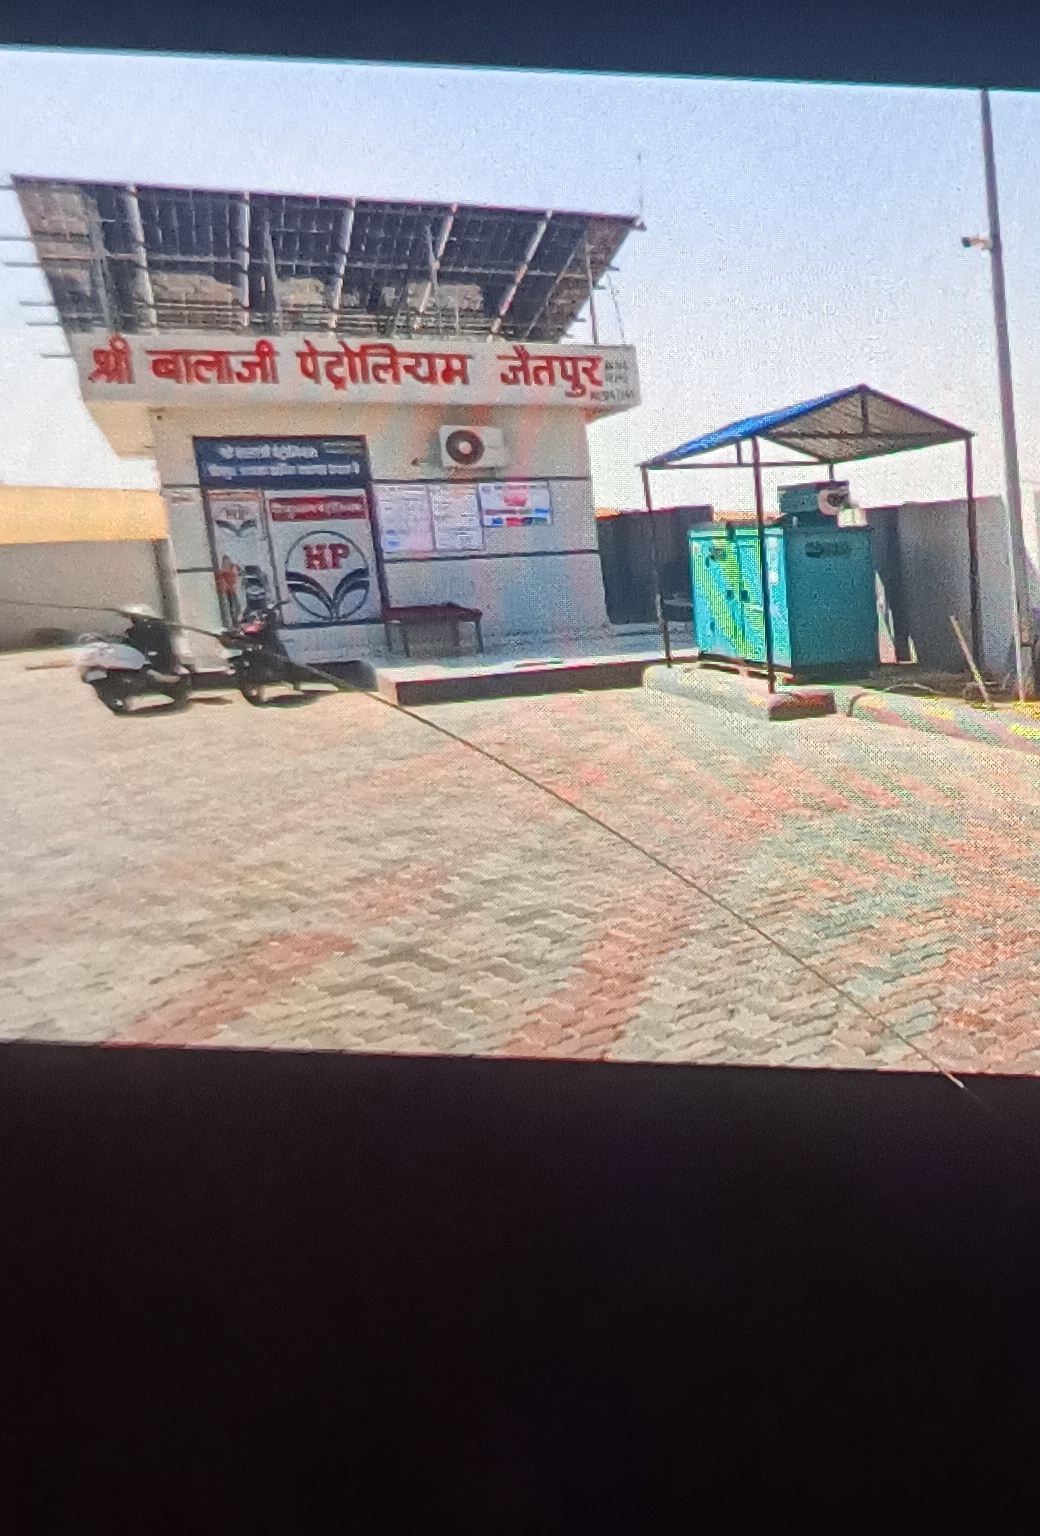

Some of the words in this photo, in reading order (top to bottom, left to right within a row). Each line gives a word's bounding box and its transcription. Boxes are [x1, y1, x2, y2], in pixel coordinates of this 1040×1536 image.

[88, 333, 136, 384] श्री
[145, 339, 279, 384] बालाजी
[296, 339, 473, 391] पेट्रोलियम
[497, 345, 603, 398] जैतपुर
[304, 543, 349, 570] HP
